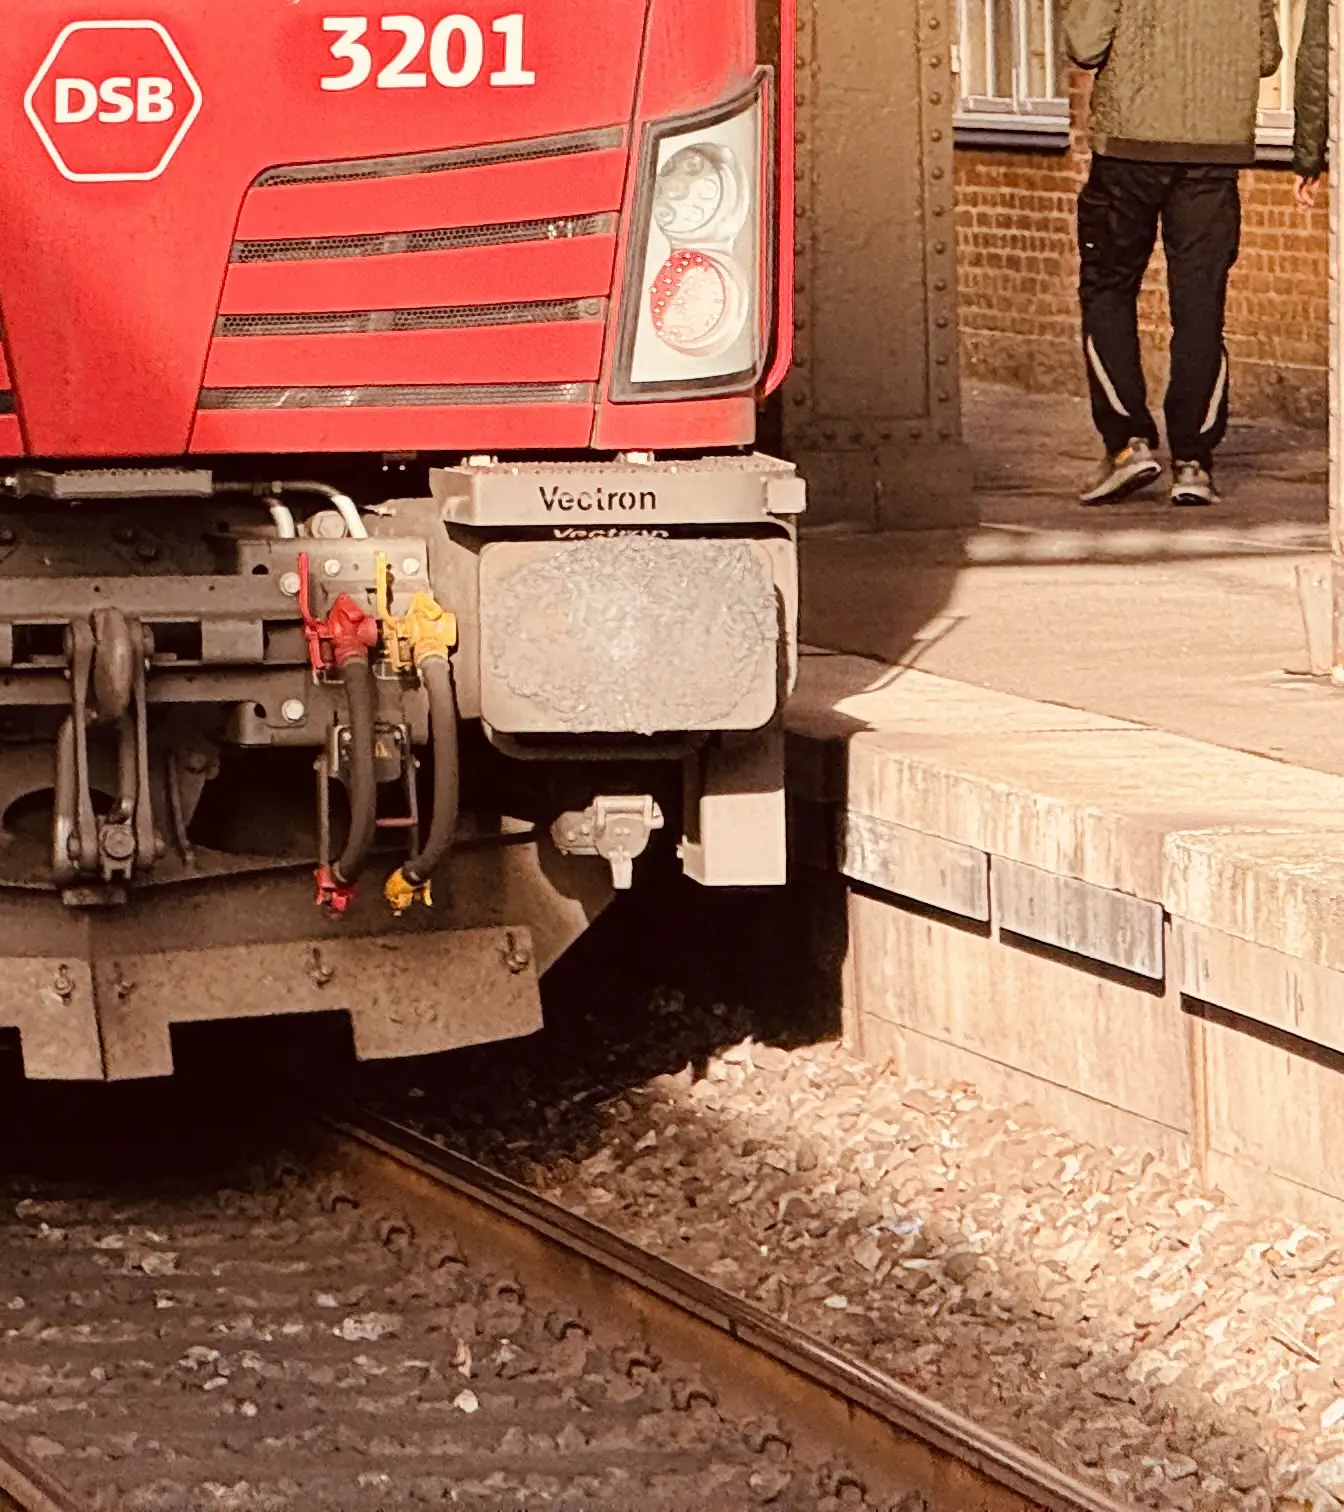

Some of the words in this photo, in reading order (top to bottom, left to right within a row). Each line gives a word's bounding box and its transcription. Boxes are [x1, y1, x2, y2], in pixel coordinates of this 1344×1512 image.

[320, 13, 536, 91] 3201
[55, 76, 175, 123] DSB
[538, 485, 657, 512] Vectron
